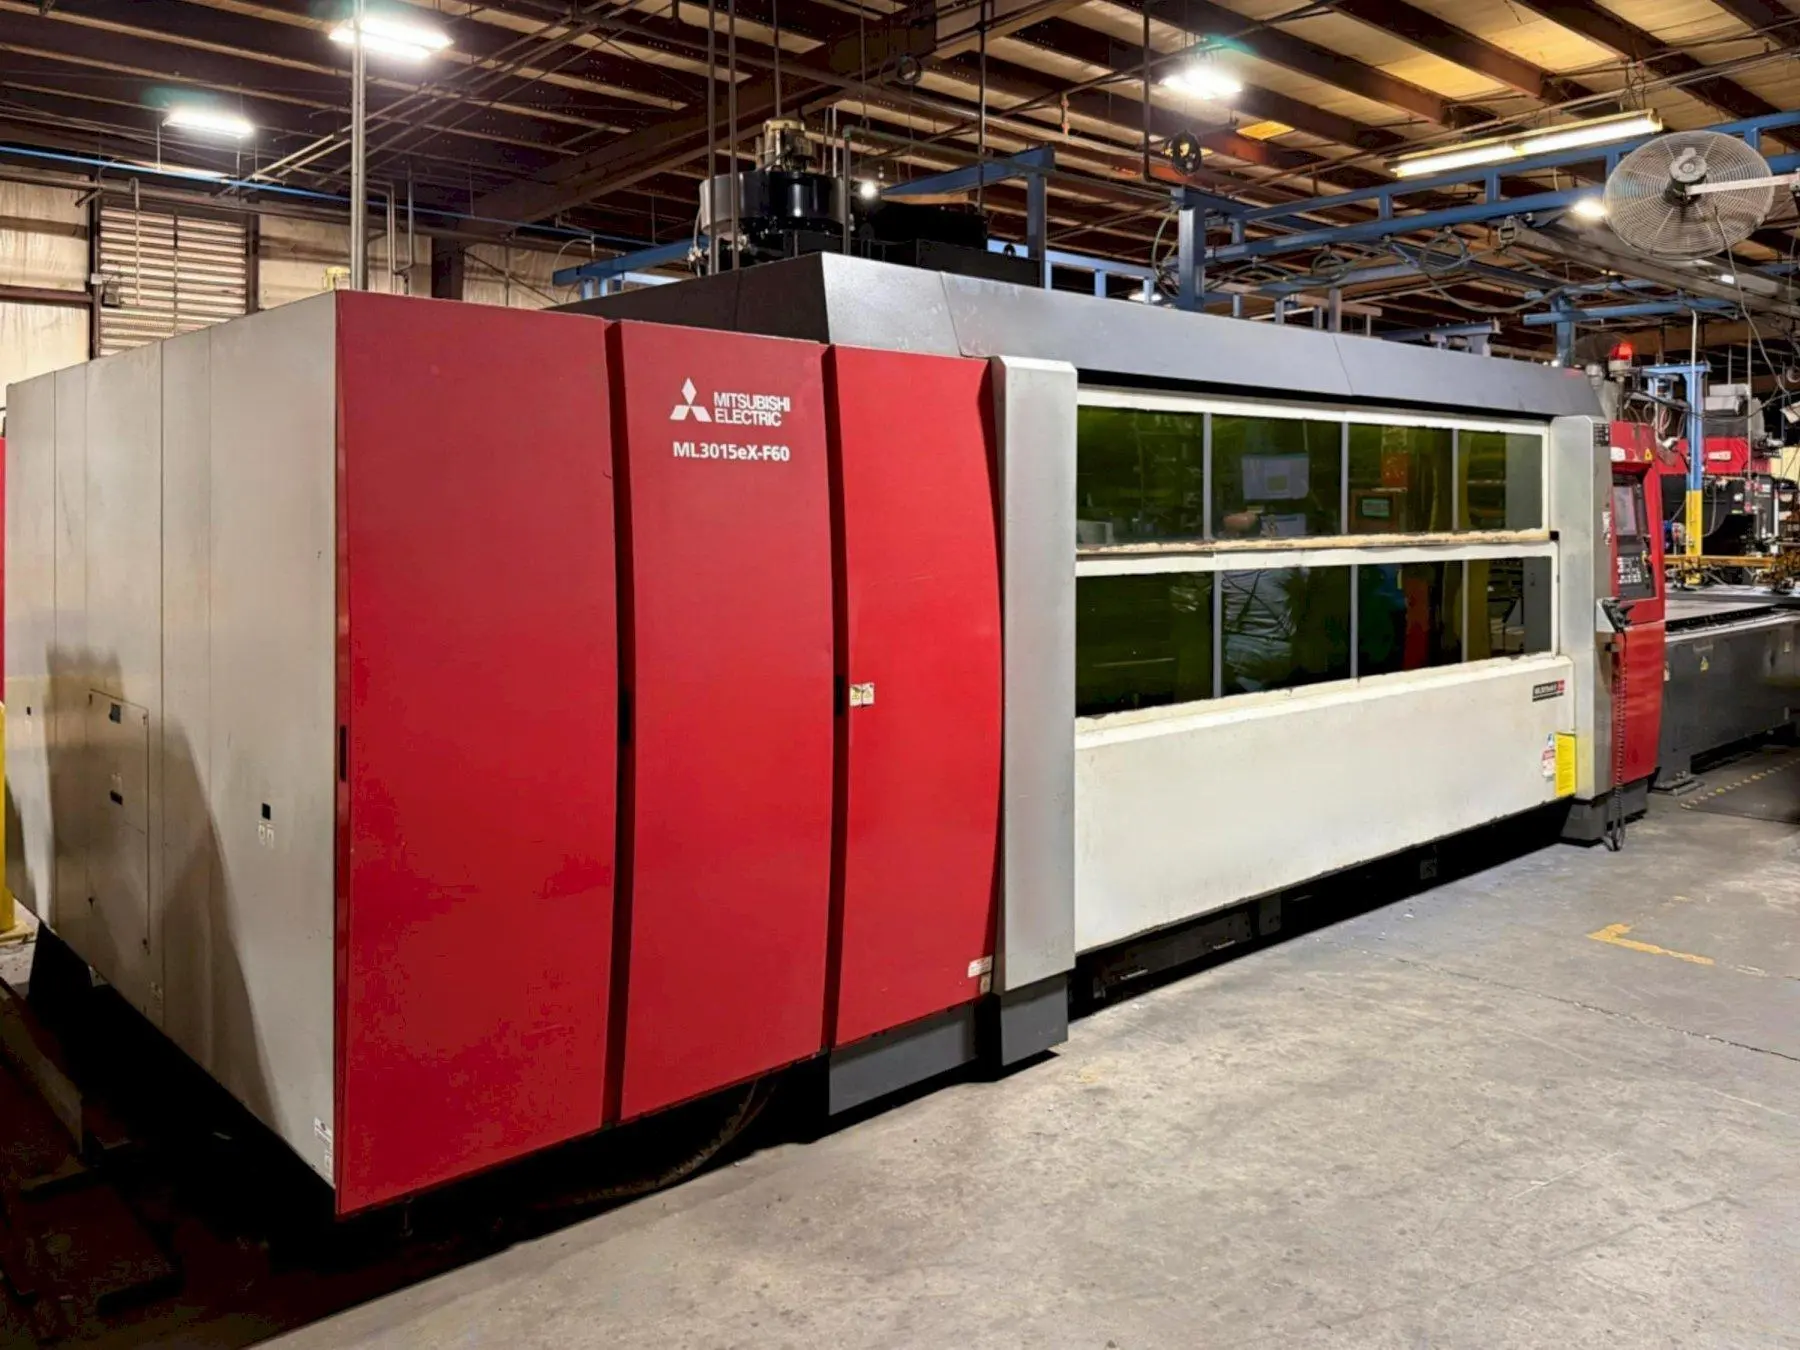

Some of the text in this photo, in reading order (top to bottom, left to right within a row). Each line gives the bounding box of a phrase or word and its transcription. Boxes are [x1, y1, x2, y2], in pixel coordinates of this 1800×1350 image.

[713, 392, 791, 412] MITSUBISHI
[715, 409, 782, 427] ELECTRIC
[673, 441, 790, 462] ML3015eX-F60
